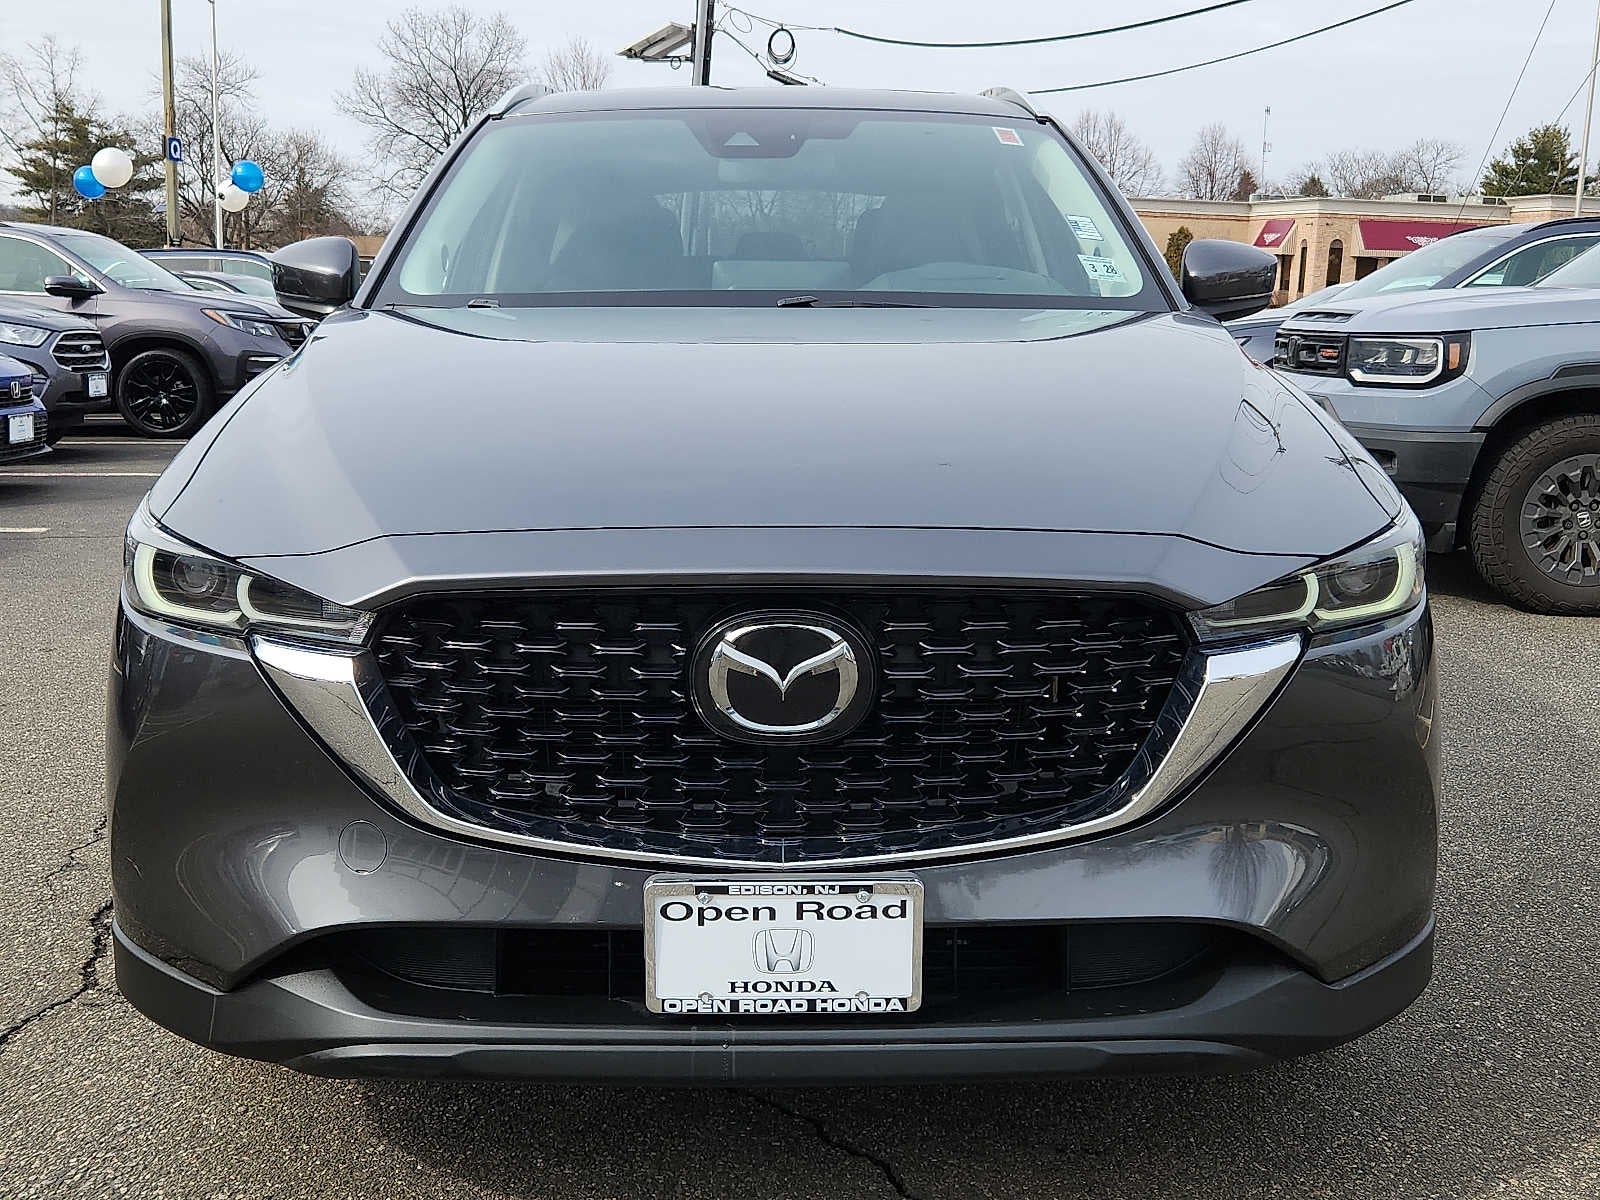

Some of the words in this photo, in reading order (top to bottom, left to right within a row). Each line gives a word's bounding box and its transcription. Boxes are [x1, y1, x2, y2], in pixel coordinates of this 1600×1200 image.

[170, 140, 181, 159] Q
[1088, 263, 1098, 273] 3
[728, 885, 808, 896] EDISON,
[814, 884, 841, 896] NJ
[659, 901, 777, 927] Open
[795, 899, 908, 922] Road
[727, 980, 840, 994] HONDA
[663, 998, 731, 1013] OPEN
[736, 998, 809, 1013] ROAD
[815, 998, 905, 1013] HONDA
